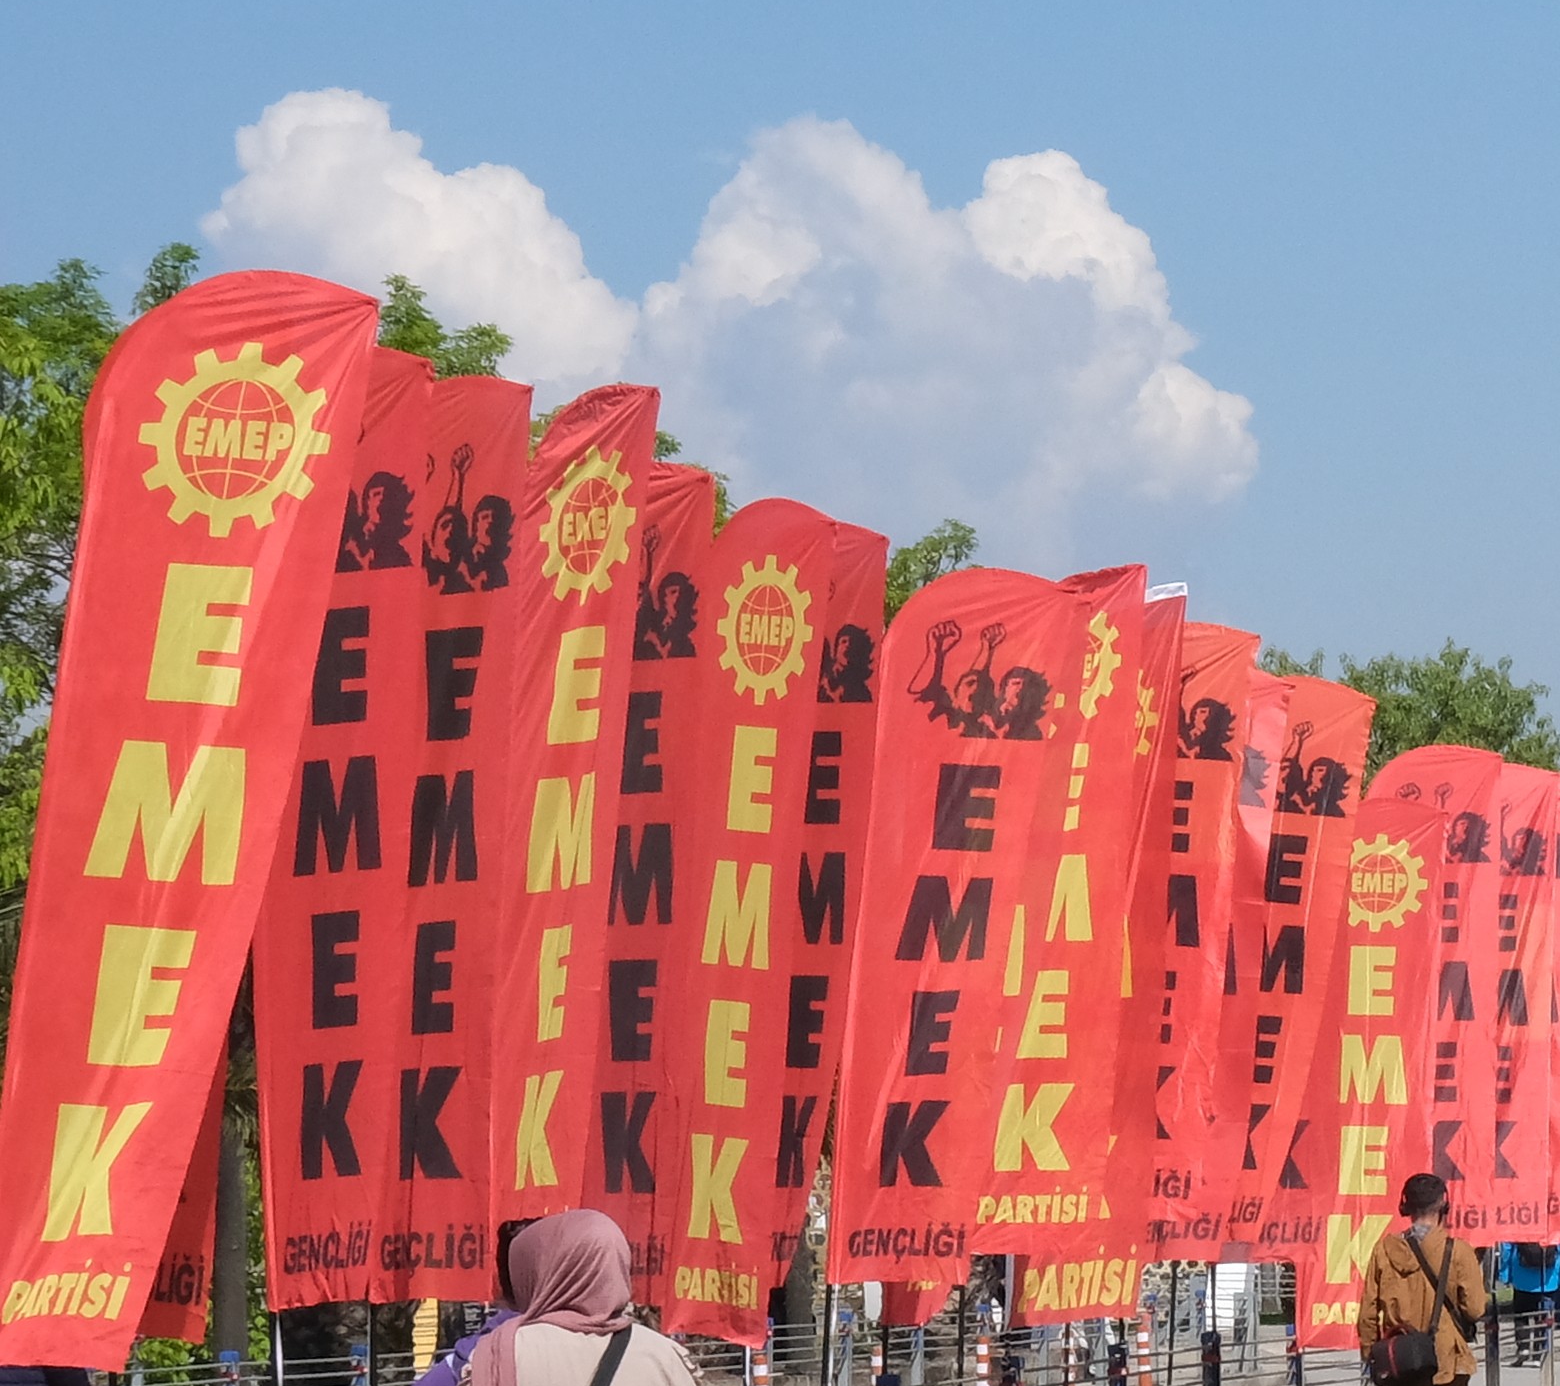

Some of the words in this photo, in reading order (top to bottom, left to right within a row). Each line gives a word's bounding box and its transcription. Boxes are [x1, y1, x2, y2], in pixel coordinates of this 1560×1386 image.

[186, 415, 293, 459] EMEP
[562, 507, 607, 546] EME
[739, 609, 793, 648] EMEP
[44, 564, 253, 1241] EMEK
[293, 608, 381, 1179] EMEK
[401, 627, 483, 1178] EMEK
[515, 625, 604, 1186] EMEK
[604, 691, 672, 1193] EMEK
[689, 725, 779, 1244] EMEK
[879, 764, 1001, 1187] EMEK
[1352, 873, 1406, 893] EMEP
[977, 1186, 1088, 1225] PARTİSİ
[1326, 946, 1406, 1283] EMEK
[1, 1259, 132, 1324] PARTİSİ
[848, 1223, 965, 1263] GENÇLİĞİ
[1017, 1244, 1137, 1313] PARTİSİ
